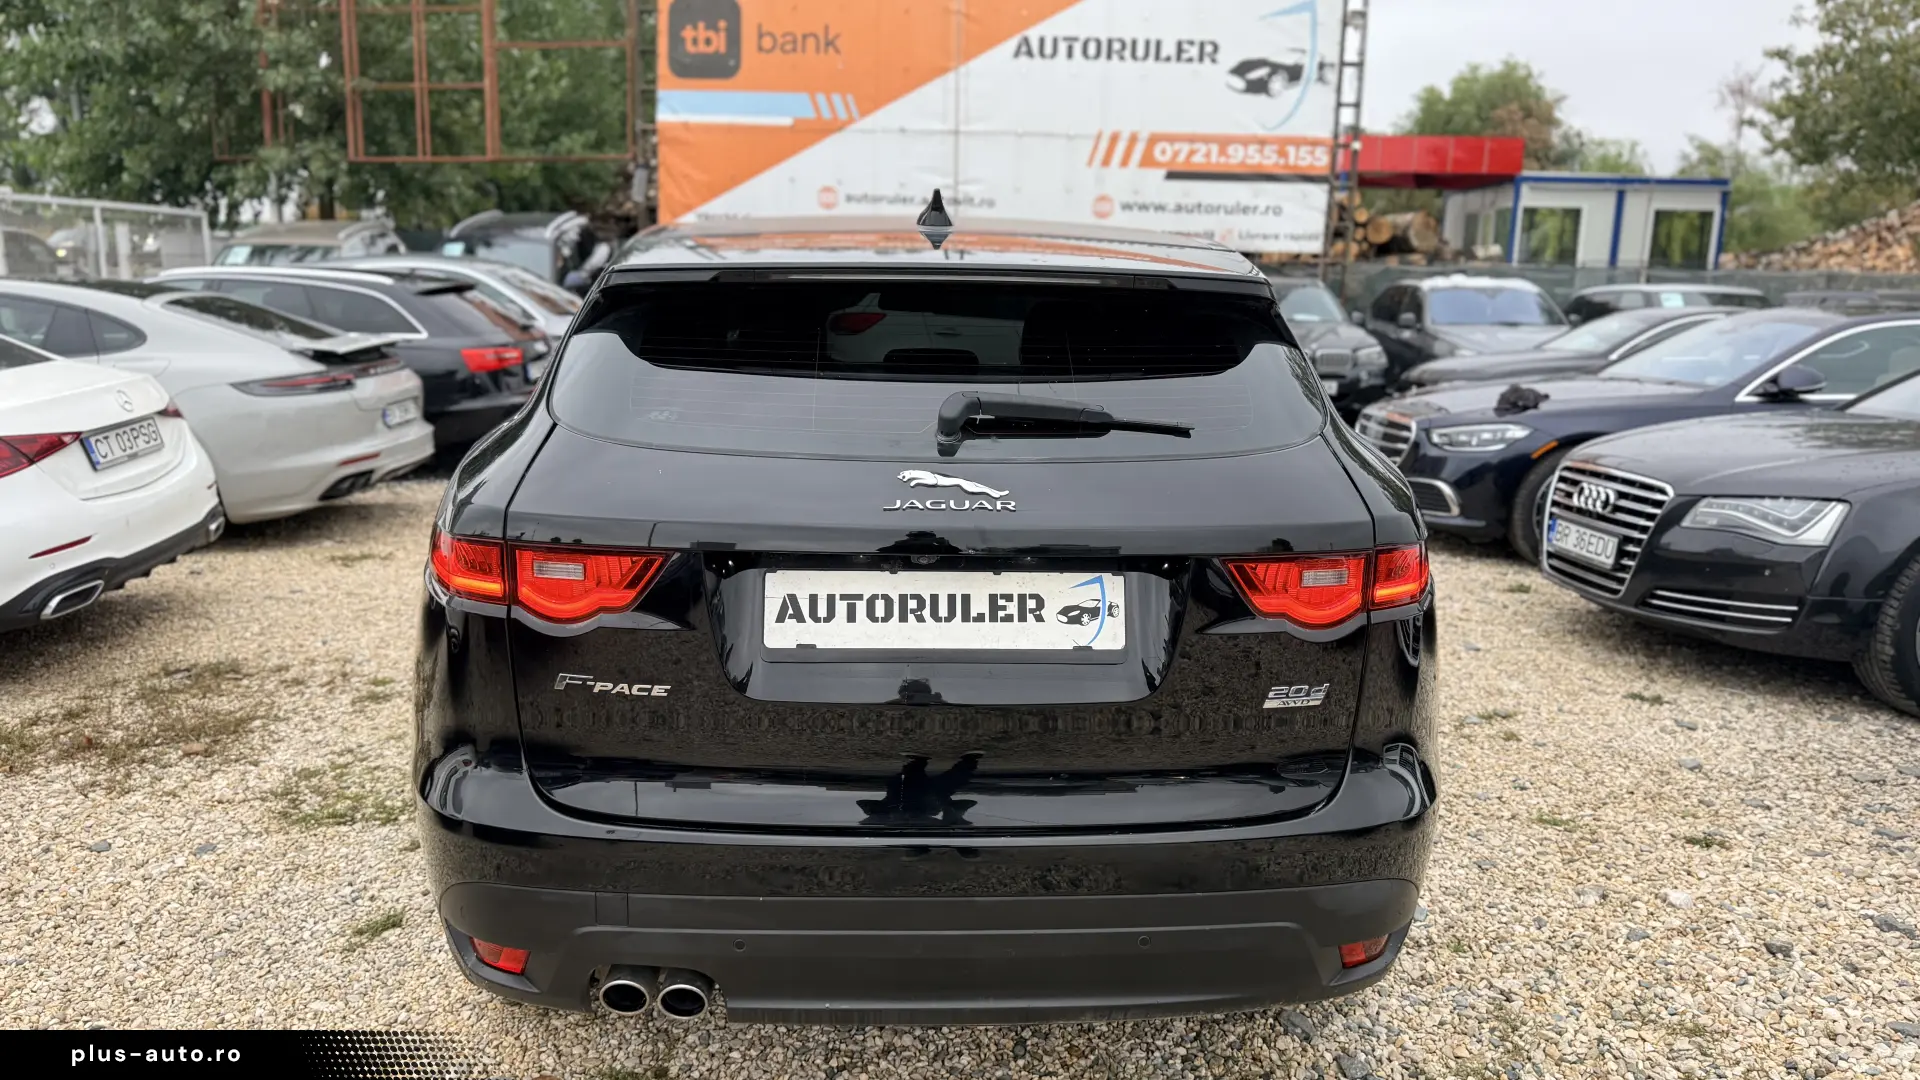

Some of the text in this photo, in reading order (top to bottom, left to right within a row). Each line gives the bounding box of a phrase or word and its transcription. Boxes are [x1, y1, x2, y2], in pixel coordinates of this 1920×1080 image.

[680, 19, 842, 55] tbi bank
[1012, 35, 1221, 64] AUTORULER
[1153, 141, 1329, 167] 0721.955.155
[1120, 200, 1284, 218] www.autoruler.ro
[94, 422, 158, 459] CT 03PSG
[883, 499, 1016, 512] JAGUAR
[1555, 522, 1616, 559] BR 36EDU
[775, 593, 1046, 624] AUTORULER
[554, 673, 671, 696] F-PACE
[1268, 683, 1330, 699] 20d
